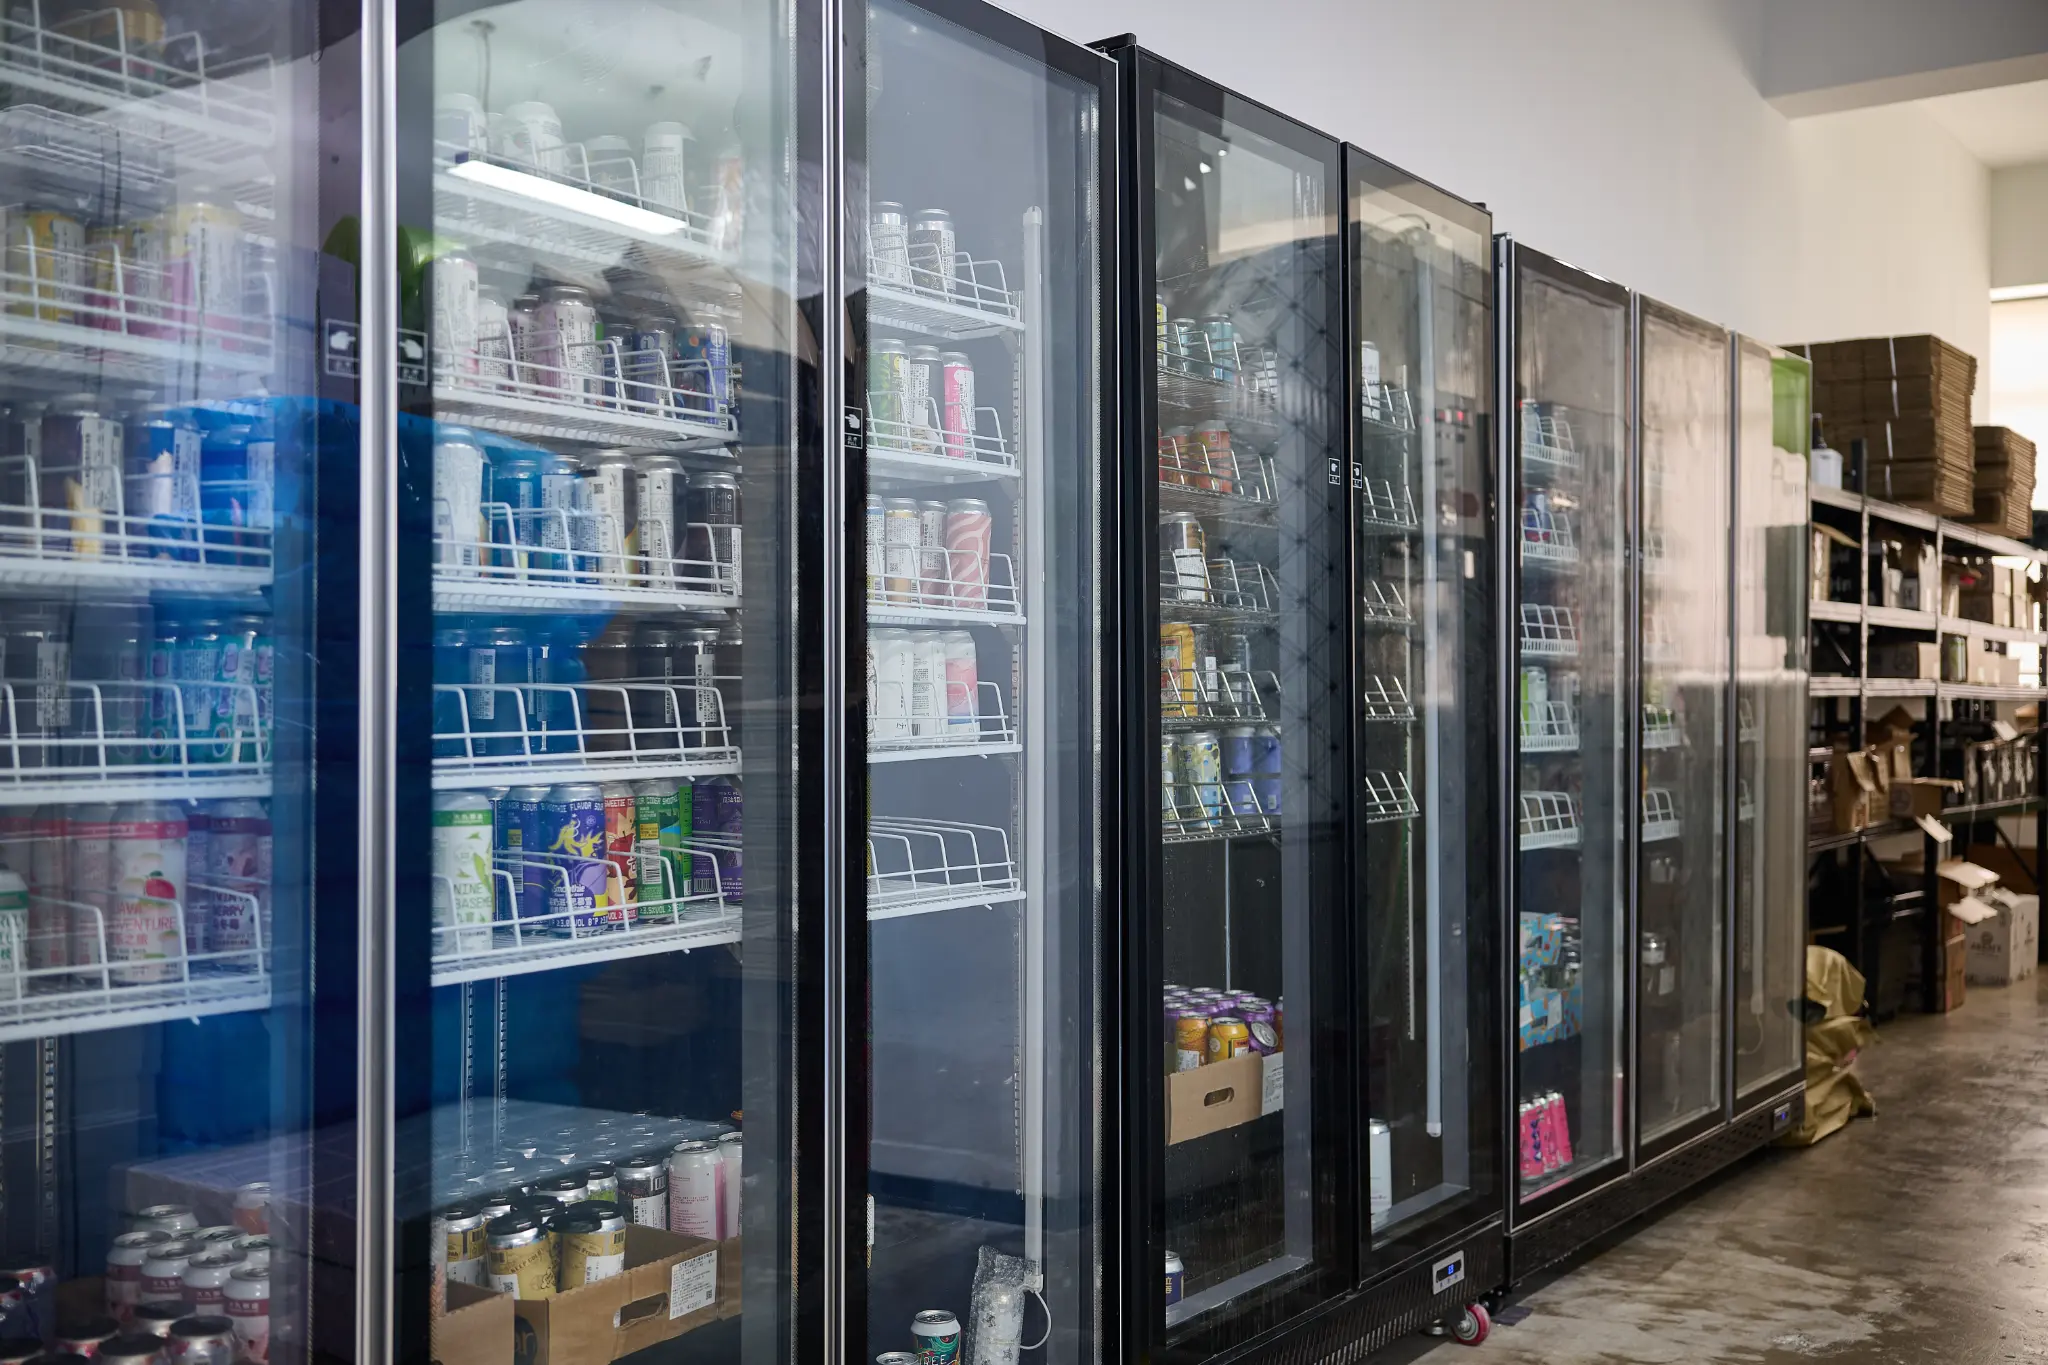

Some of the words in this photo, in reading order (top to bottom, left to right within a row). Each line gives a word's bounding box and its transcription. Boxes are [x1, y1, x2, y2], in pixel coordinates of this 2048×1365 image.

[569, 801, 592, 811] FLAVOR
[453, 883, 483, 895] NINE
[553, 884, 586, 893] Smothie
[510, 1259, 528, 1273] KEEP
